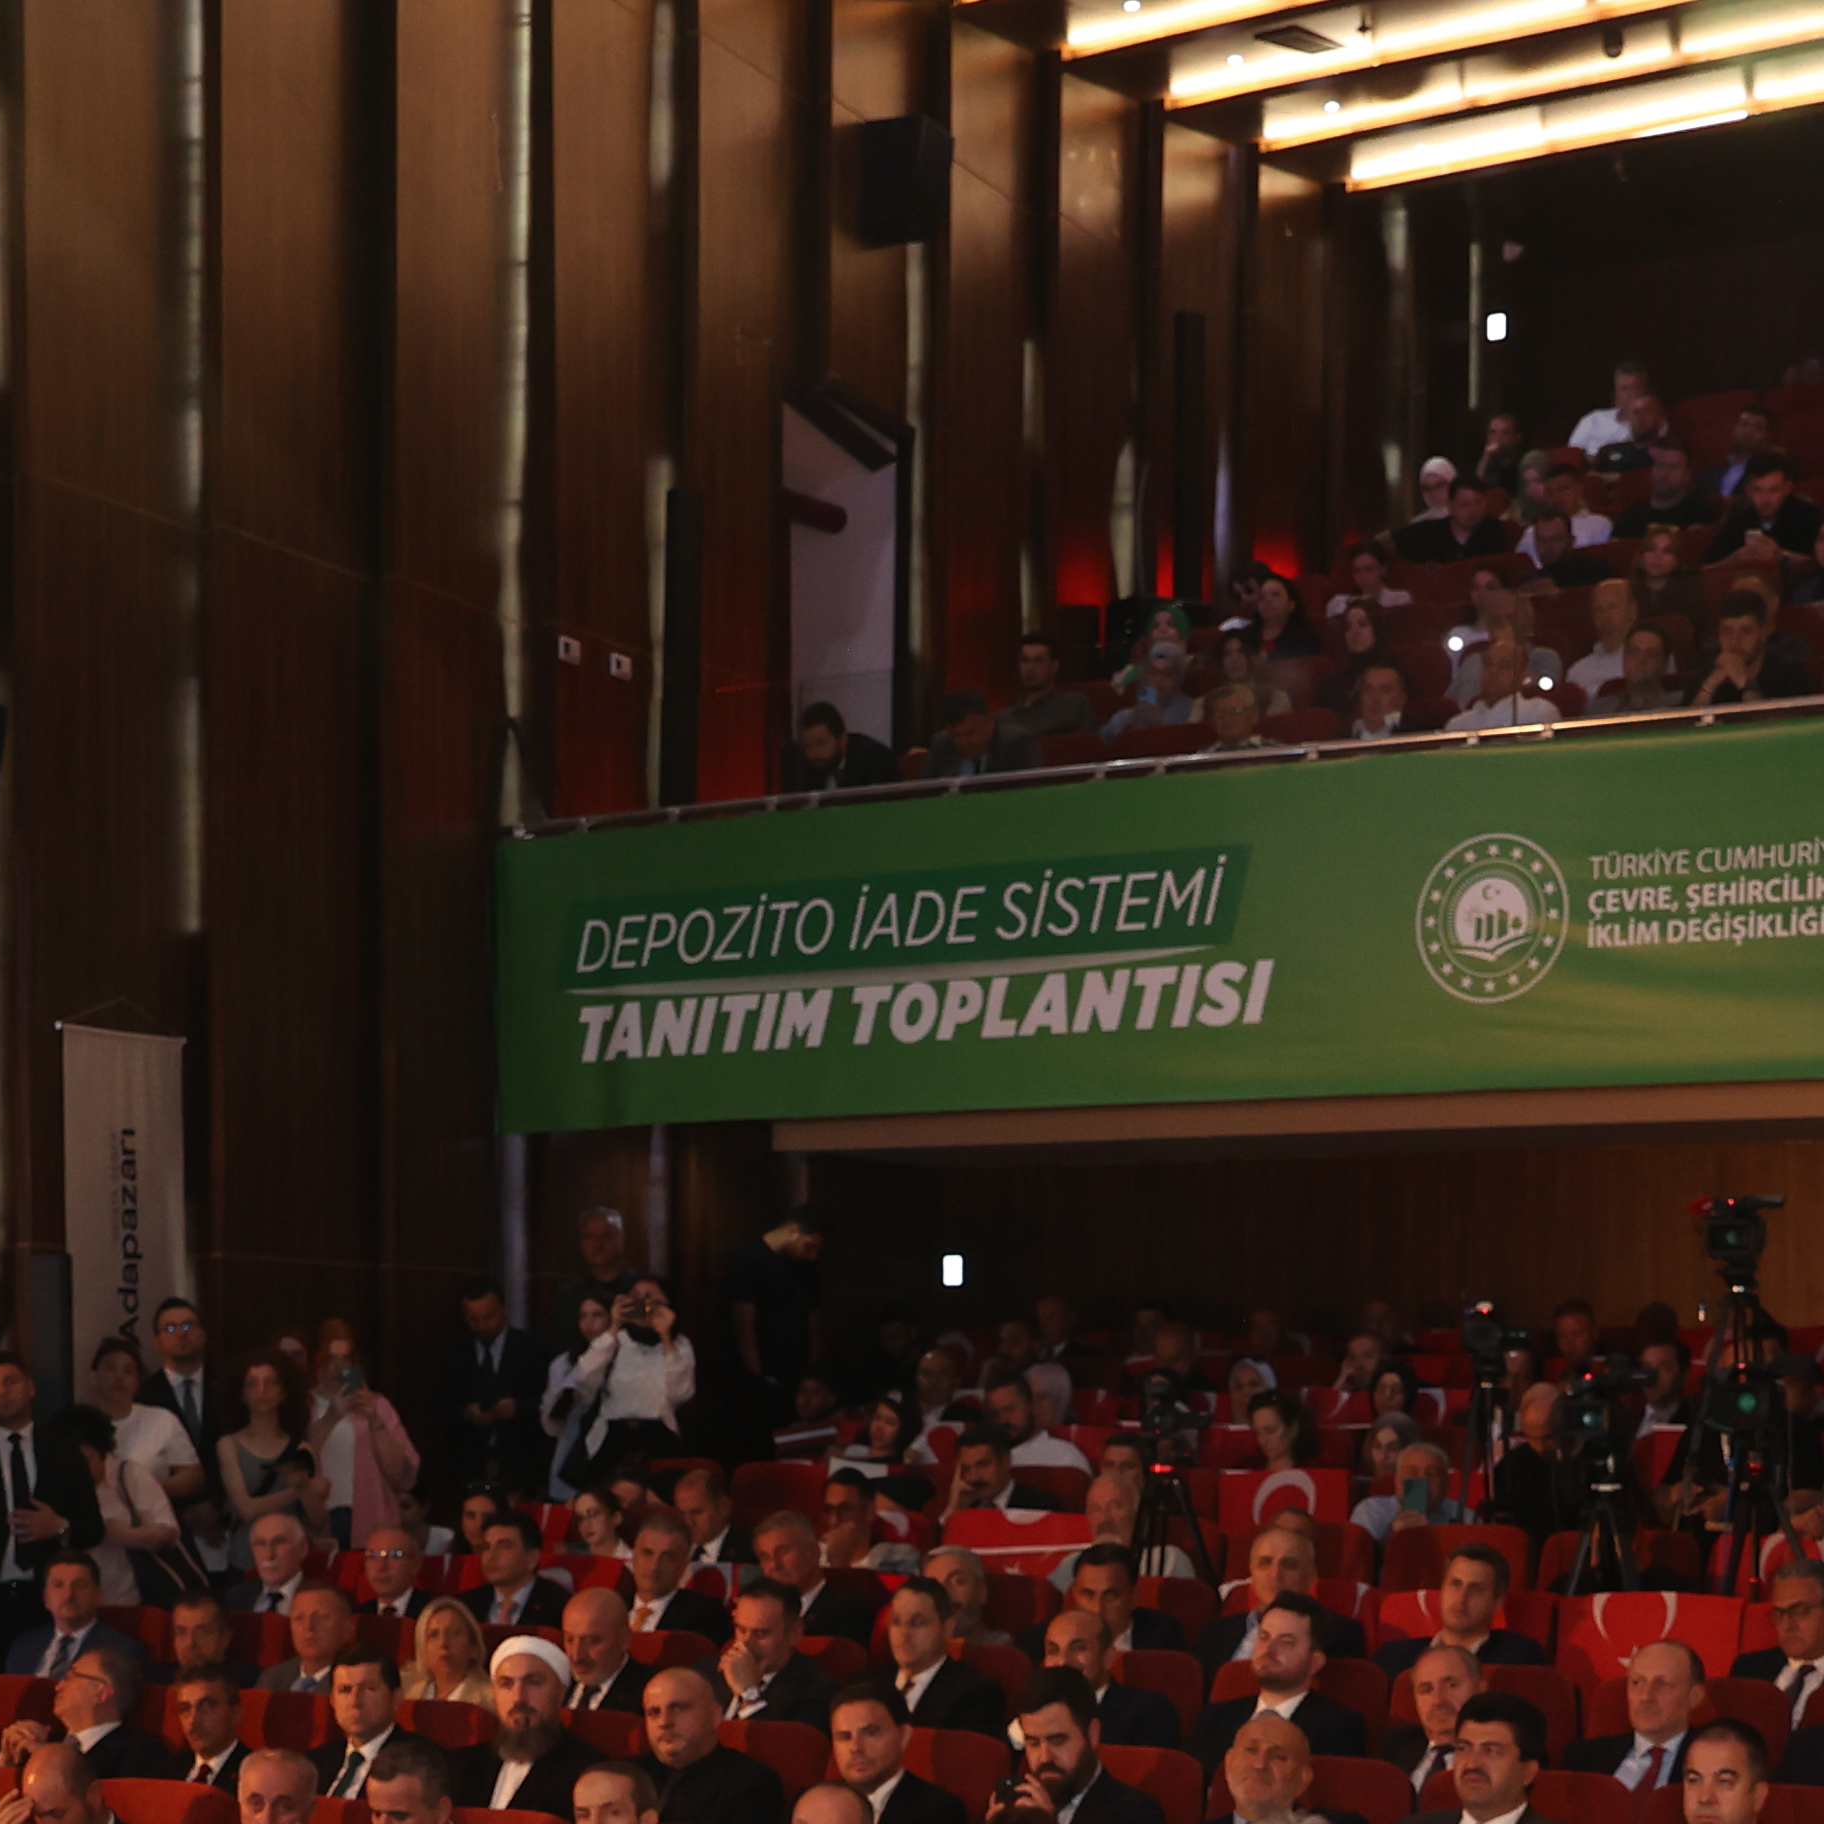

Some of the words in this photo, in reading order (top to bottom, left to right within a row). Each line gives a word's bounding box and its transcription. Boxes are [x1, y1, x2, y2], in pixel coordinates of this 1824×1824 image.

[1588, 848, 1690, 880] TÜRKİYE
[578, 893, 835, 973] DEPOZİTO
[849, 885, 985, 951] İADE
[996, 855, 1228, 941] SİSTEMİ
[1587, 917, 1661, 948] İKLİM
[1588, 886, 1679, 920] ÇEVRE,
[579, 988, 830, 1064] TANITIM
[852, 959, 1275, 1046] TOPLANTISI
[117, 1128, 143, 1344] Adapazarı
